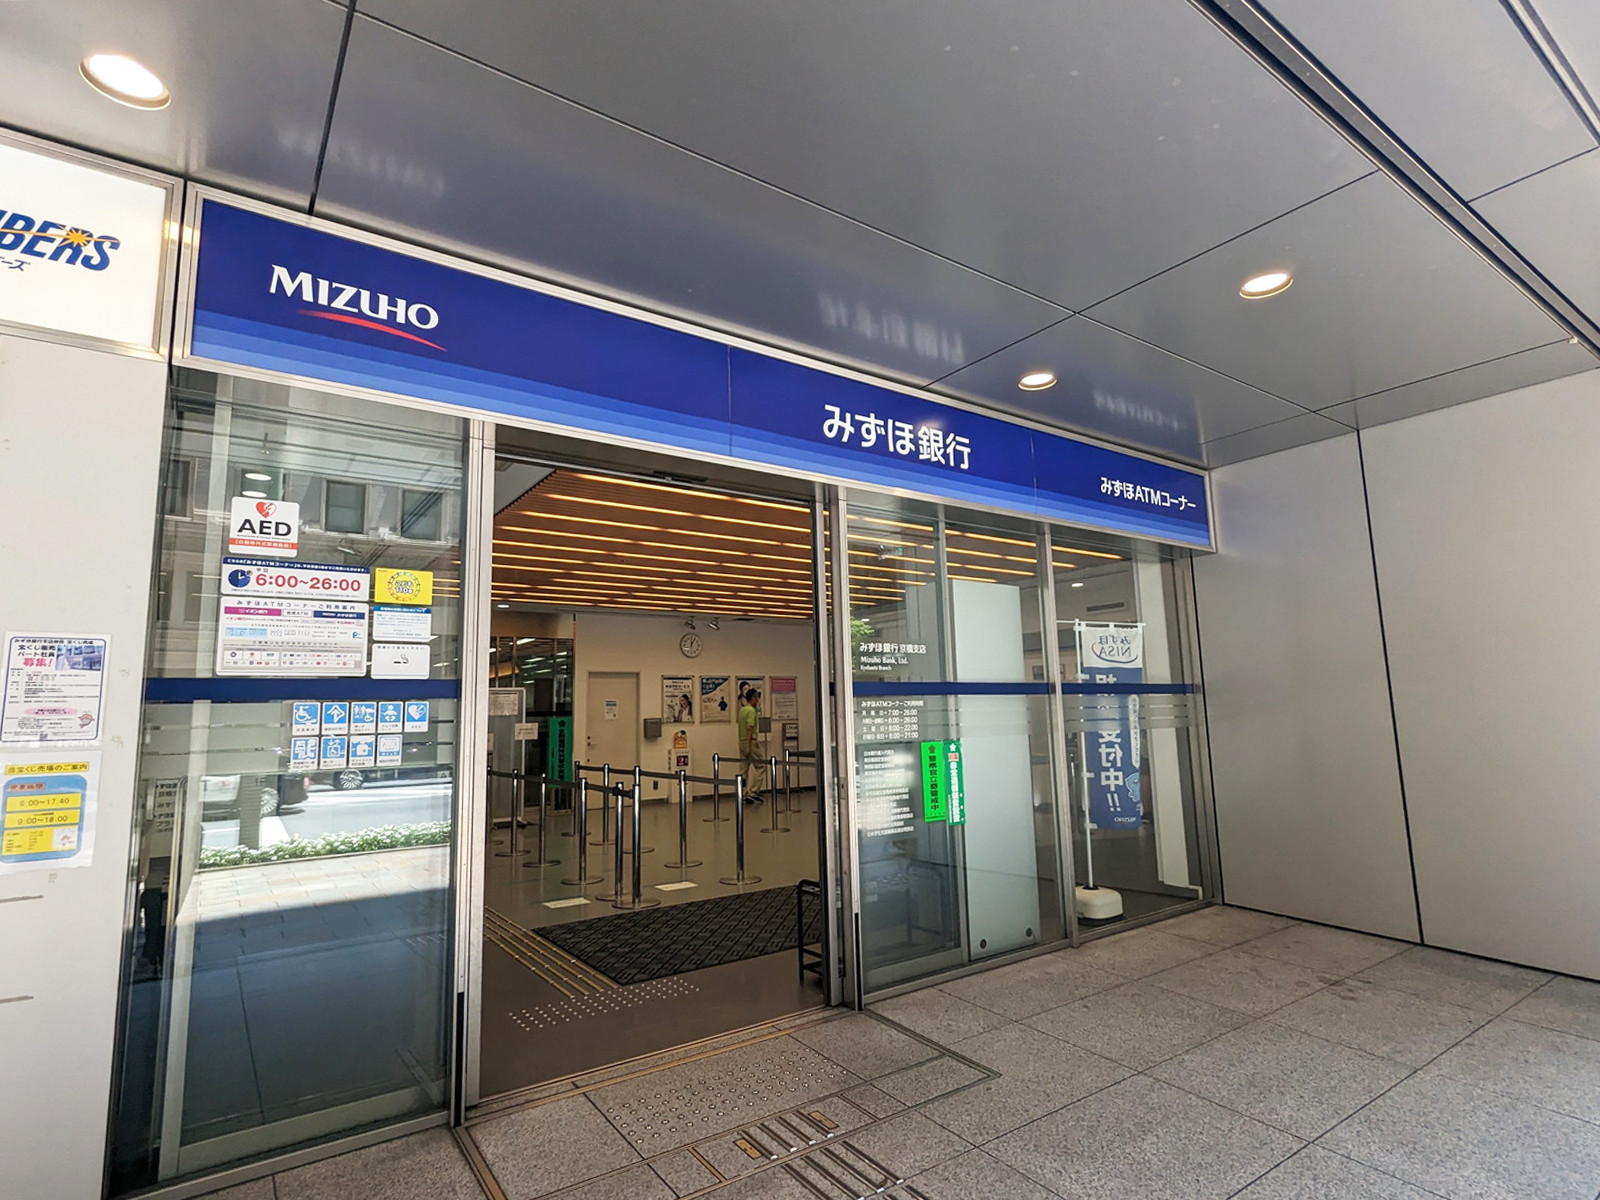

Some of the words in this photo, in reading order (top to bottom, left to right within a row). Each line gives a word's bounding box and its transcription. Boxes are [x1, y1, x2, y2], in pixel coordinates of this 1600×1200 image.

[0, 209, 120, 271] BERS
[0, 256, 31, 271] ーズ
[269, 264, 439, 330] MIZUHO
[822, 404, 971, 470] みずほ銀行
[1100, 476, 1196, 511] みずほATMコーナー
[237, 518, 292, 537] AED
[860, 642, 899, 653] みずほ銀行
